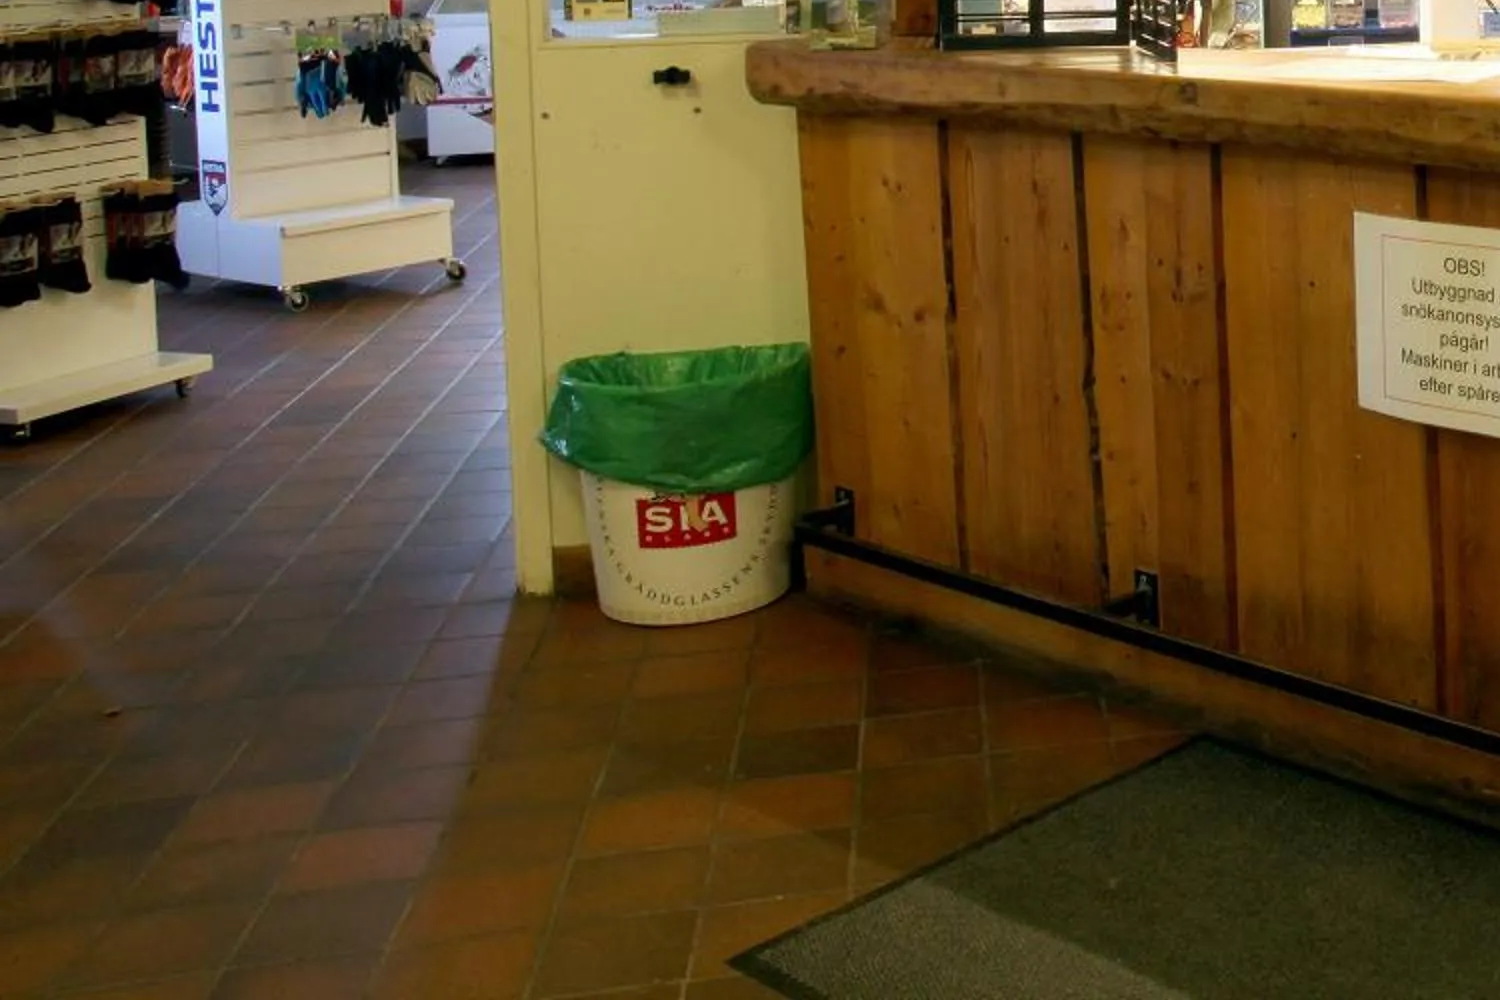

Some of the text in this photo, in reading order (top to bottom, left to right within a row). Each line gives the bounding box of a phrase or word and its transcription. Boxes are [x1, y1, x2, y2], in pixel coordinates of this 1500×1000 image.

[1443, 257, 1486, 277] OBS!
[1411, 277, 1495, 303] Utbyggnad
[1439, 331, 1489, 353] pågår!
[1401, 347, 1469, 375] Maskiner
[1419, 377, 1453, 396] efter
[644, 500, 728, 533] SIA
